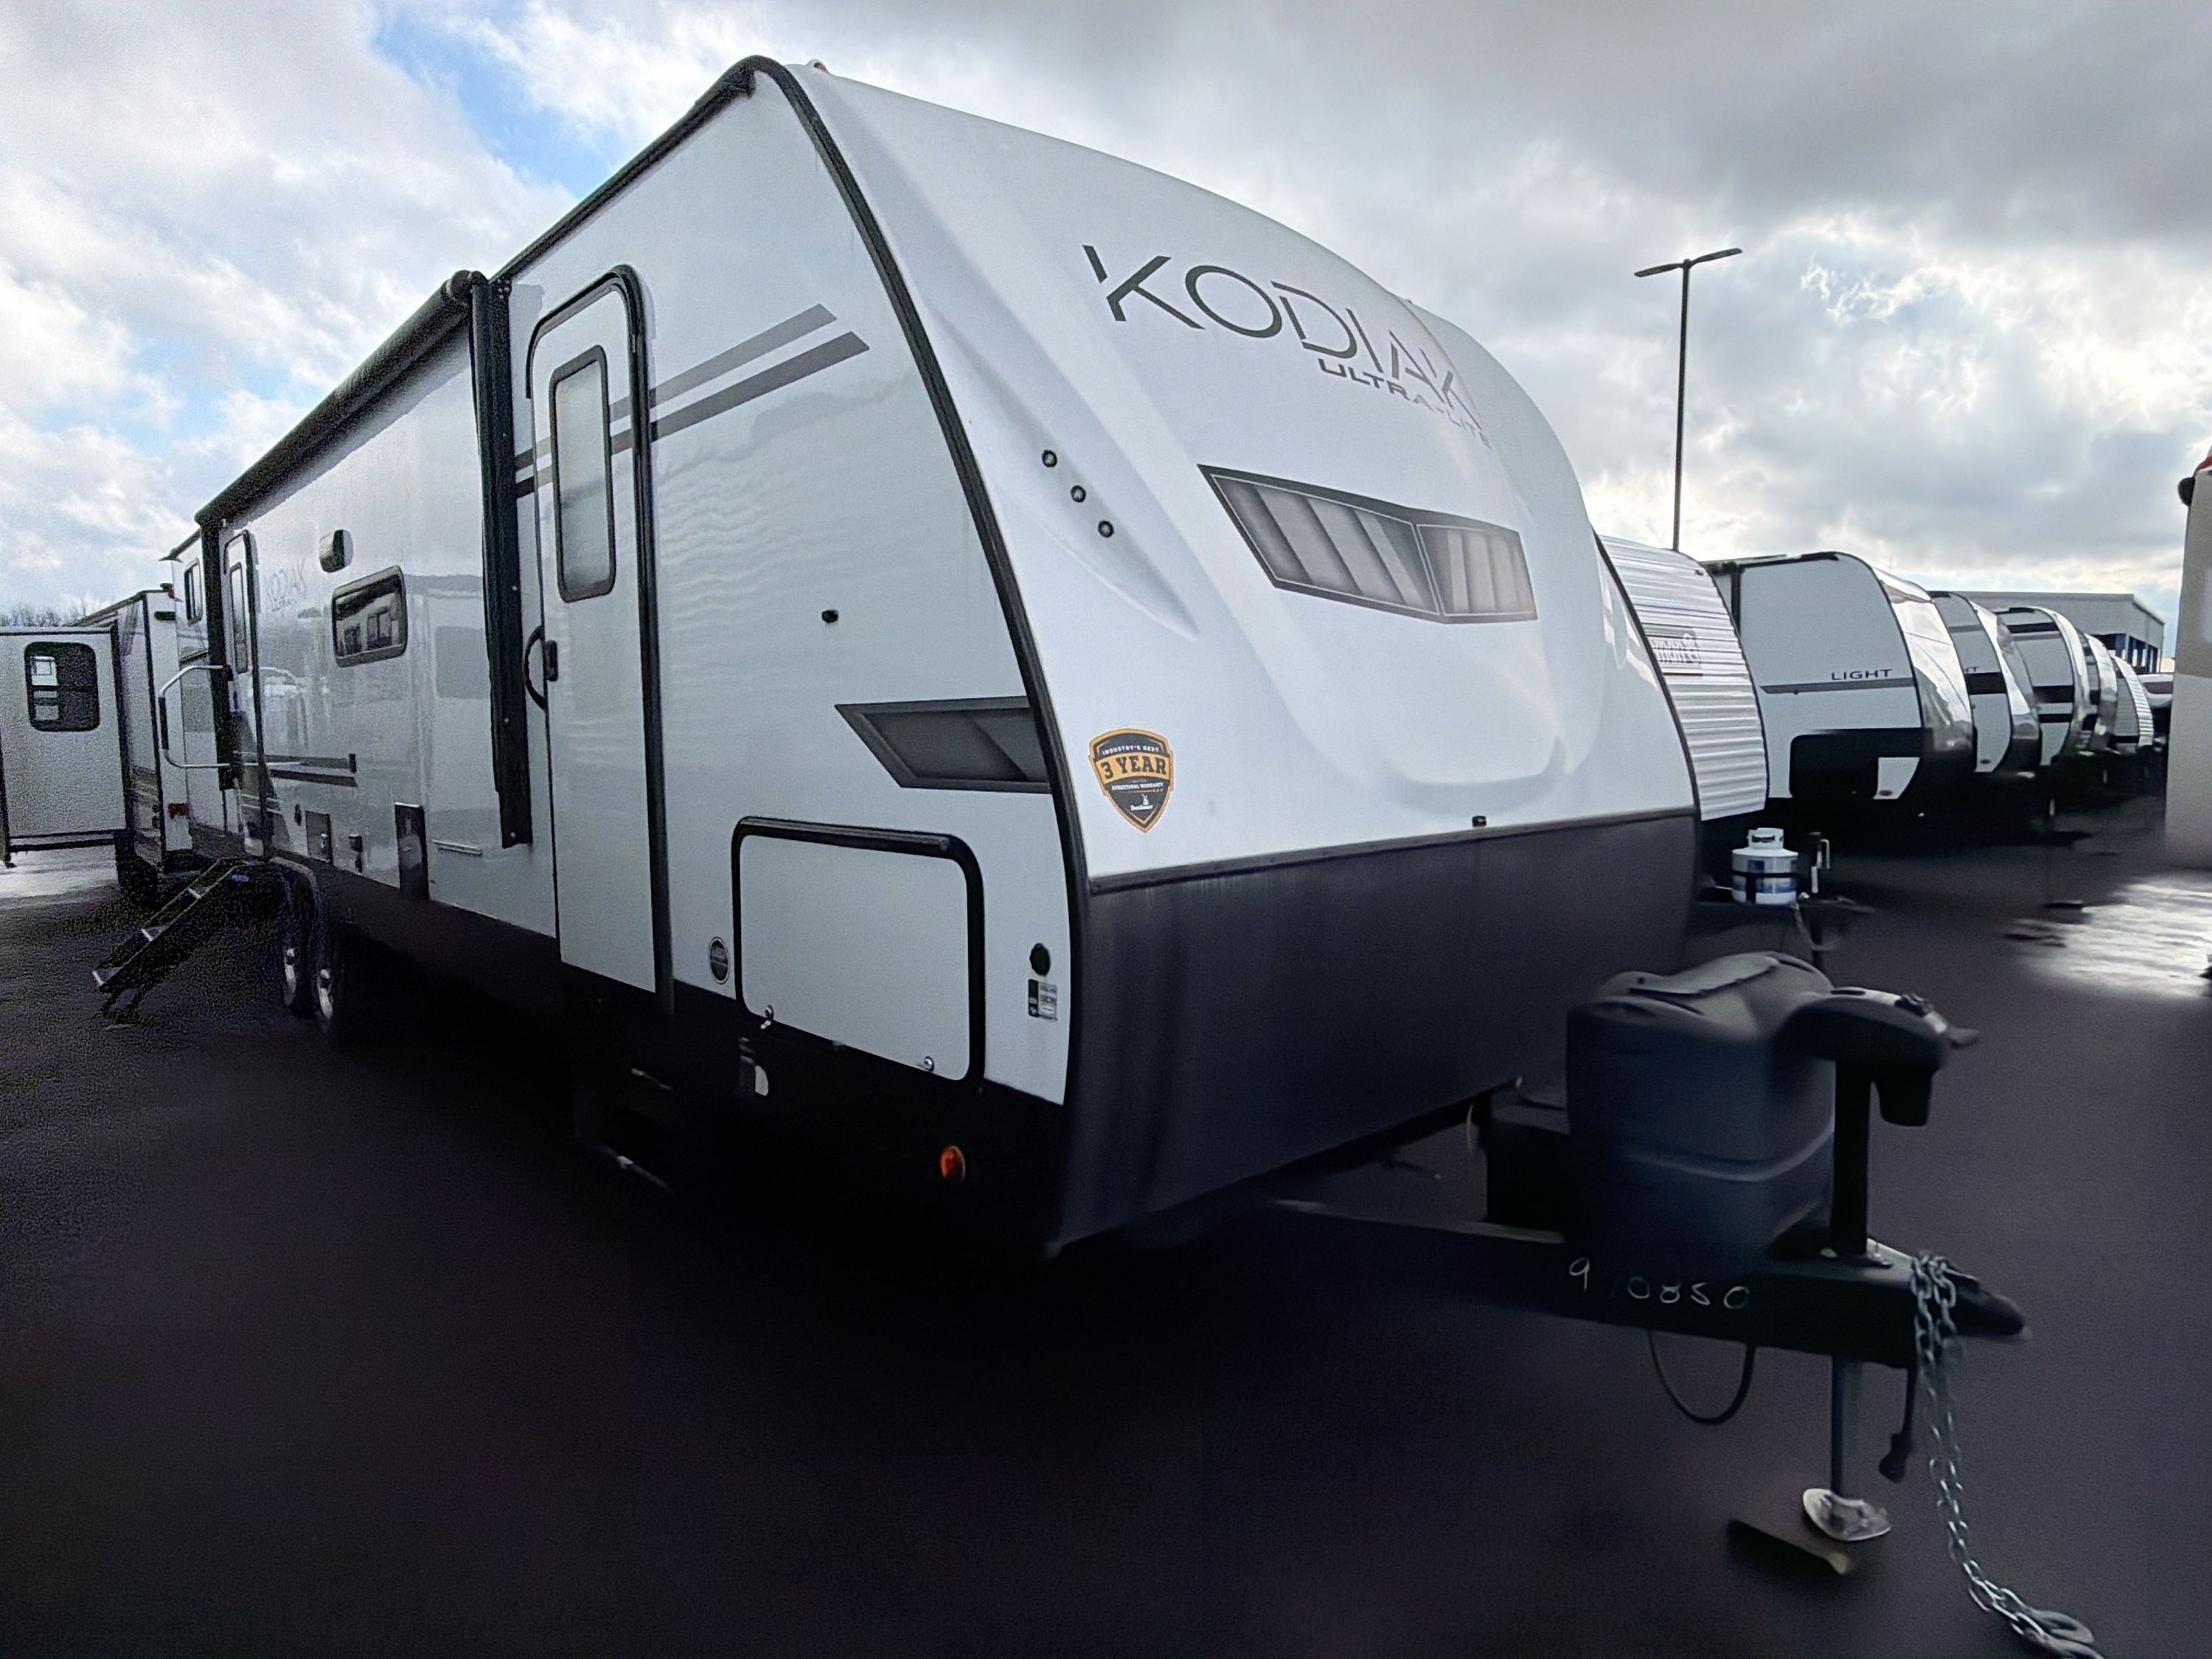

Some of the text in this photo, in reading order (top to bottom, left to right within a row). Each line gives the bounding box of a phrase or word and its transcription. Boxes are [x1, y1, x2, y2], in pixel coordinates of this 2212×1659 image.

[1083, 245, 1482, 429] KODIAK
[1831, 669, 1892, 680] LIGHT
[1101, 756, 1166, 779] 3 YEAR
